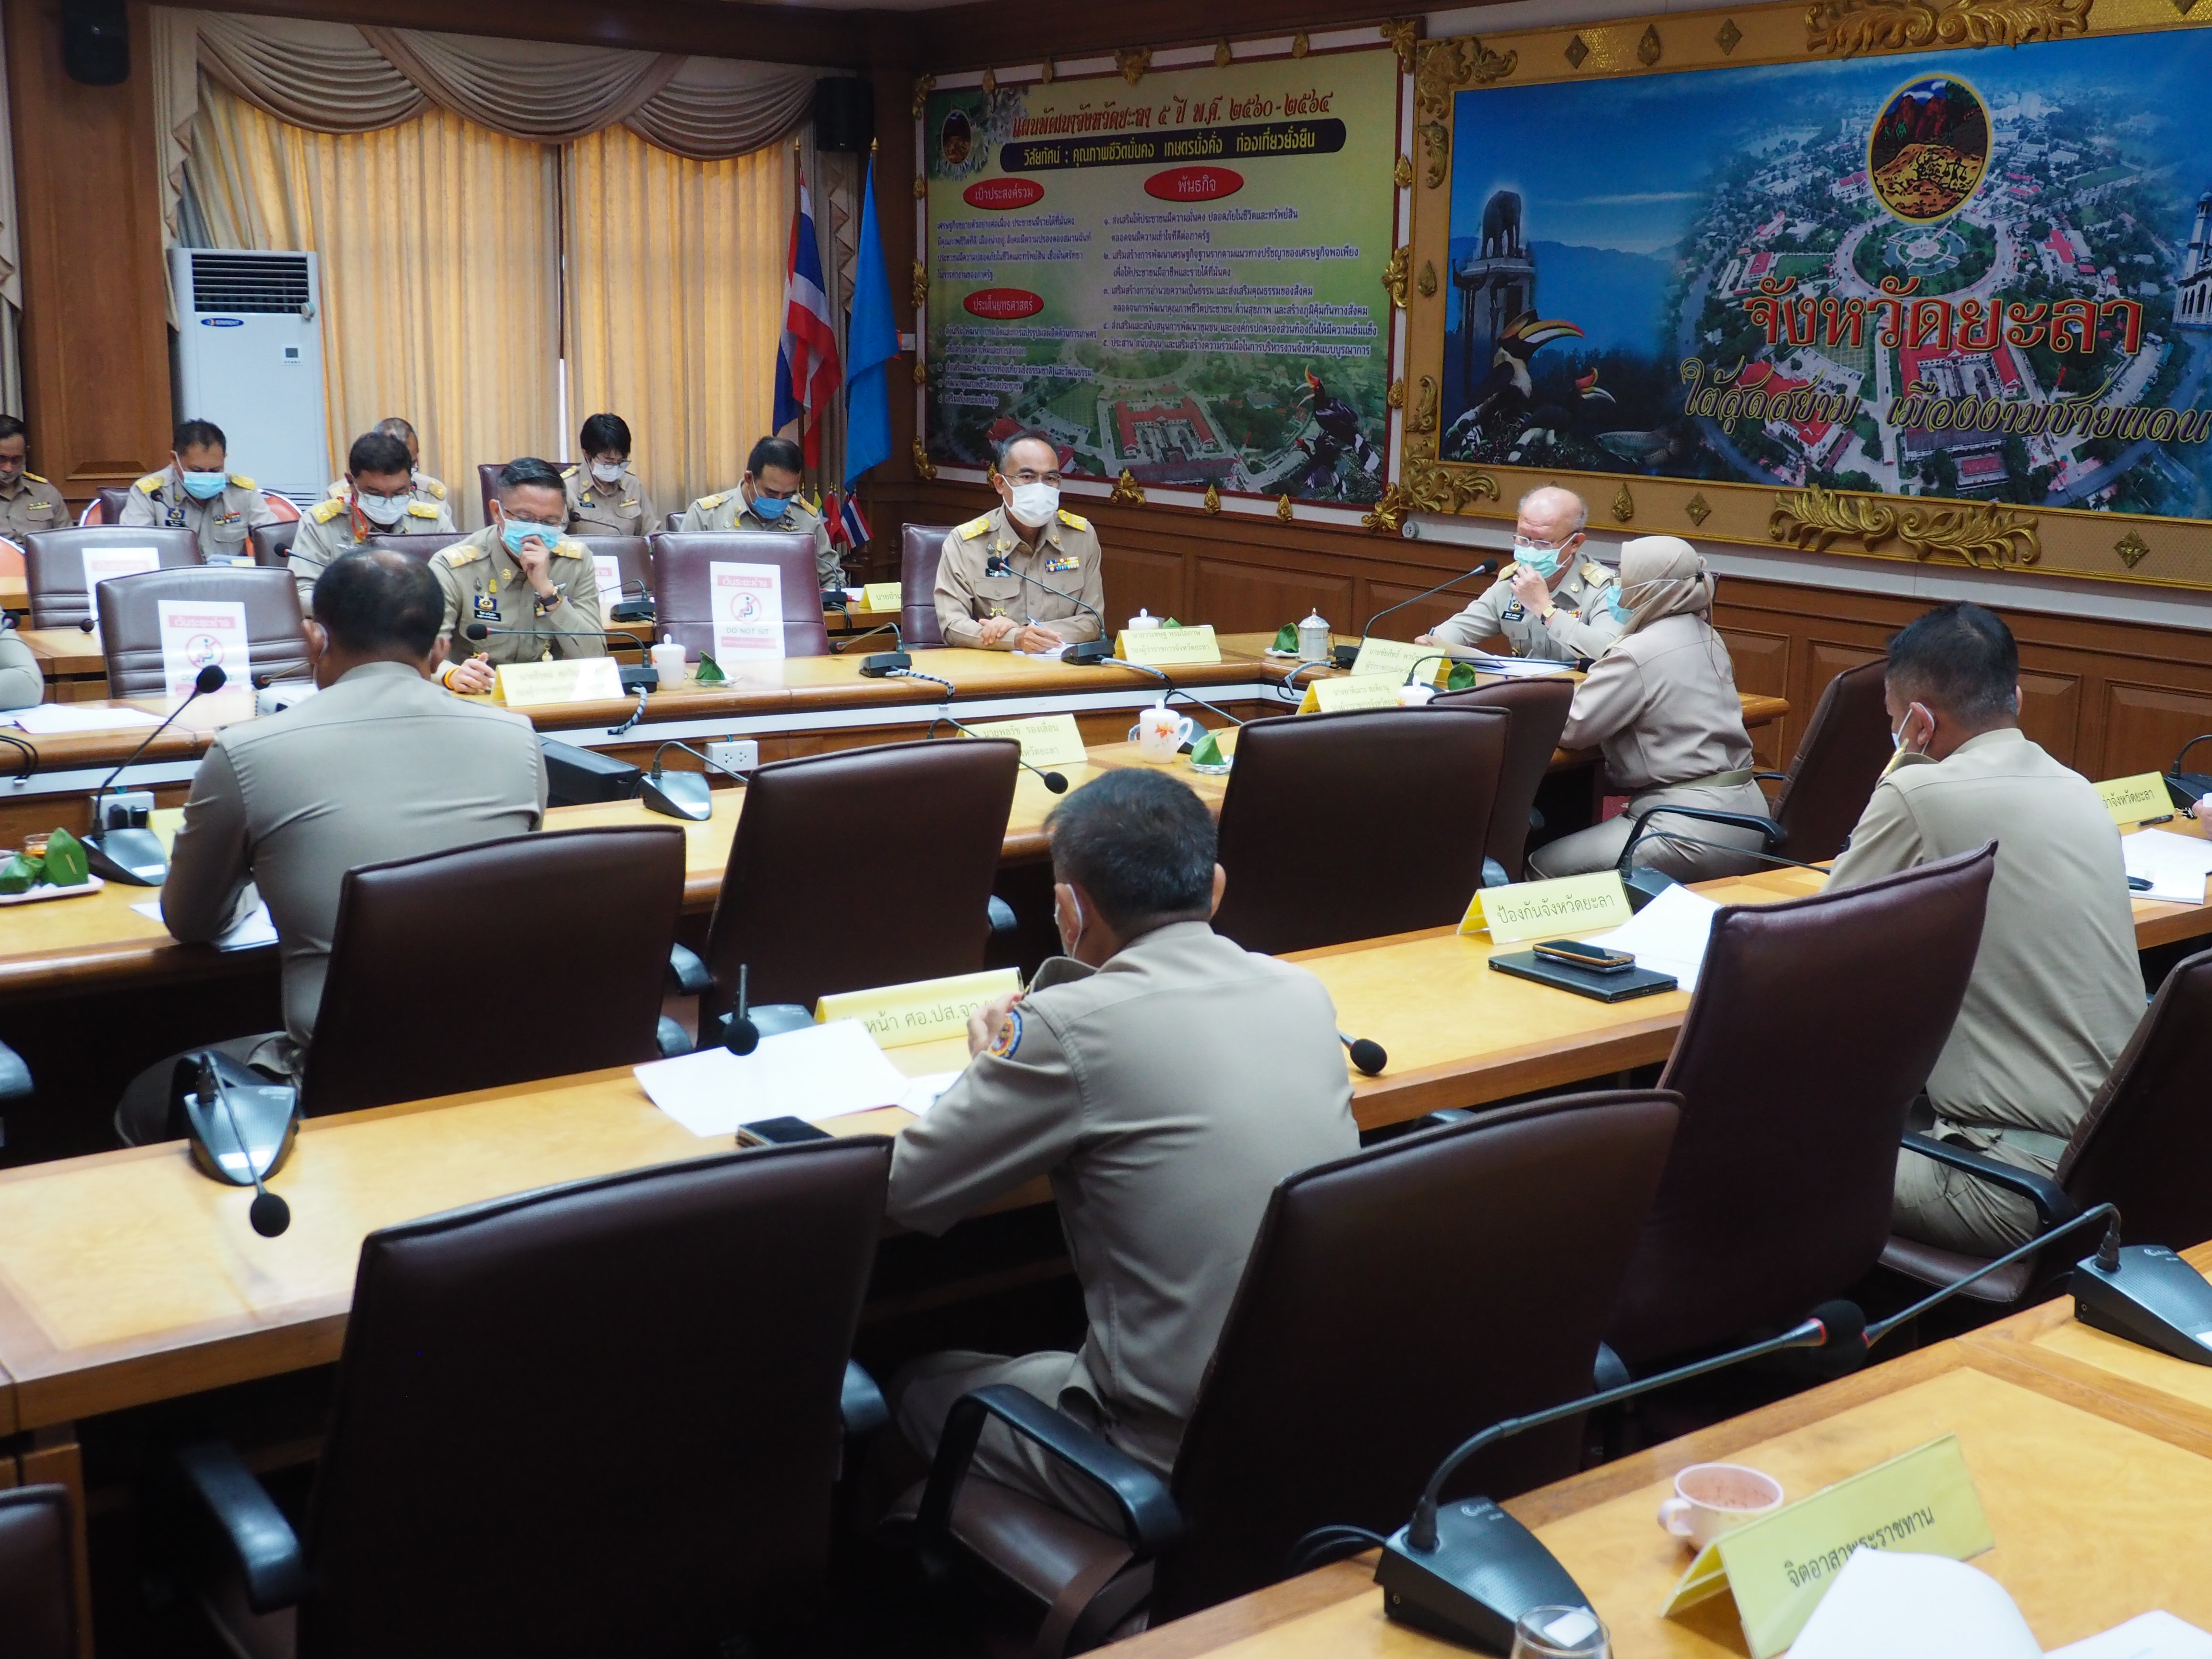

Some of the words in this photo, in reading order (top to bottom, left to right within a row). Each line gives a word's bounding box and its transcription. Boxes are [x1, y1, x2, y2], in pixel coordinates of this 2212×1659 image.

[1173, 94, 1188, 124] ปี
[1193, 96, 1223, 125] พ.ศ.
[1072, 138, 1155, 168] คุณภาพชีวิตมั่นคง
[1164, 131, 1223, 157] เกษตรมั่งคั่ง
[1236, 125, 1315, 152] ท่องเที่ยวยั่งยืน
[1177, 173, 1216, 194] พันธกิจ
[1112, 208, 1205, 225] ส่งเสริมให้ประชาชนมีความมั่นคง
[1208, 207, 1298, 222] ปลอดภัยในชีวิตและทรัพย์สิน
[1216, 284, 1313, 298] และส่งเสริมคุณธรรมของสังคม
[973, 295, 1034, 315] ประเด็นยุทธศาสตร์
[1235, 303, 1272, 317] ด้านสุขภาพ
[1274, 303, 1368, 318] และสร้างภูมิคุ้มกันทางสังคม
[1744, 276, 2143, 355] จังหวัดยะลา
[1680, 355, 1861, 434] ใต้สุดสยาม
[1886, 378, 2212, 444] เมืองงามชายแดน
[722, 576, 768, 588] เว้นระยะห่าง
[1496, 892, 1615, 925] ป้องกันจังหวัดยะลา
